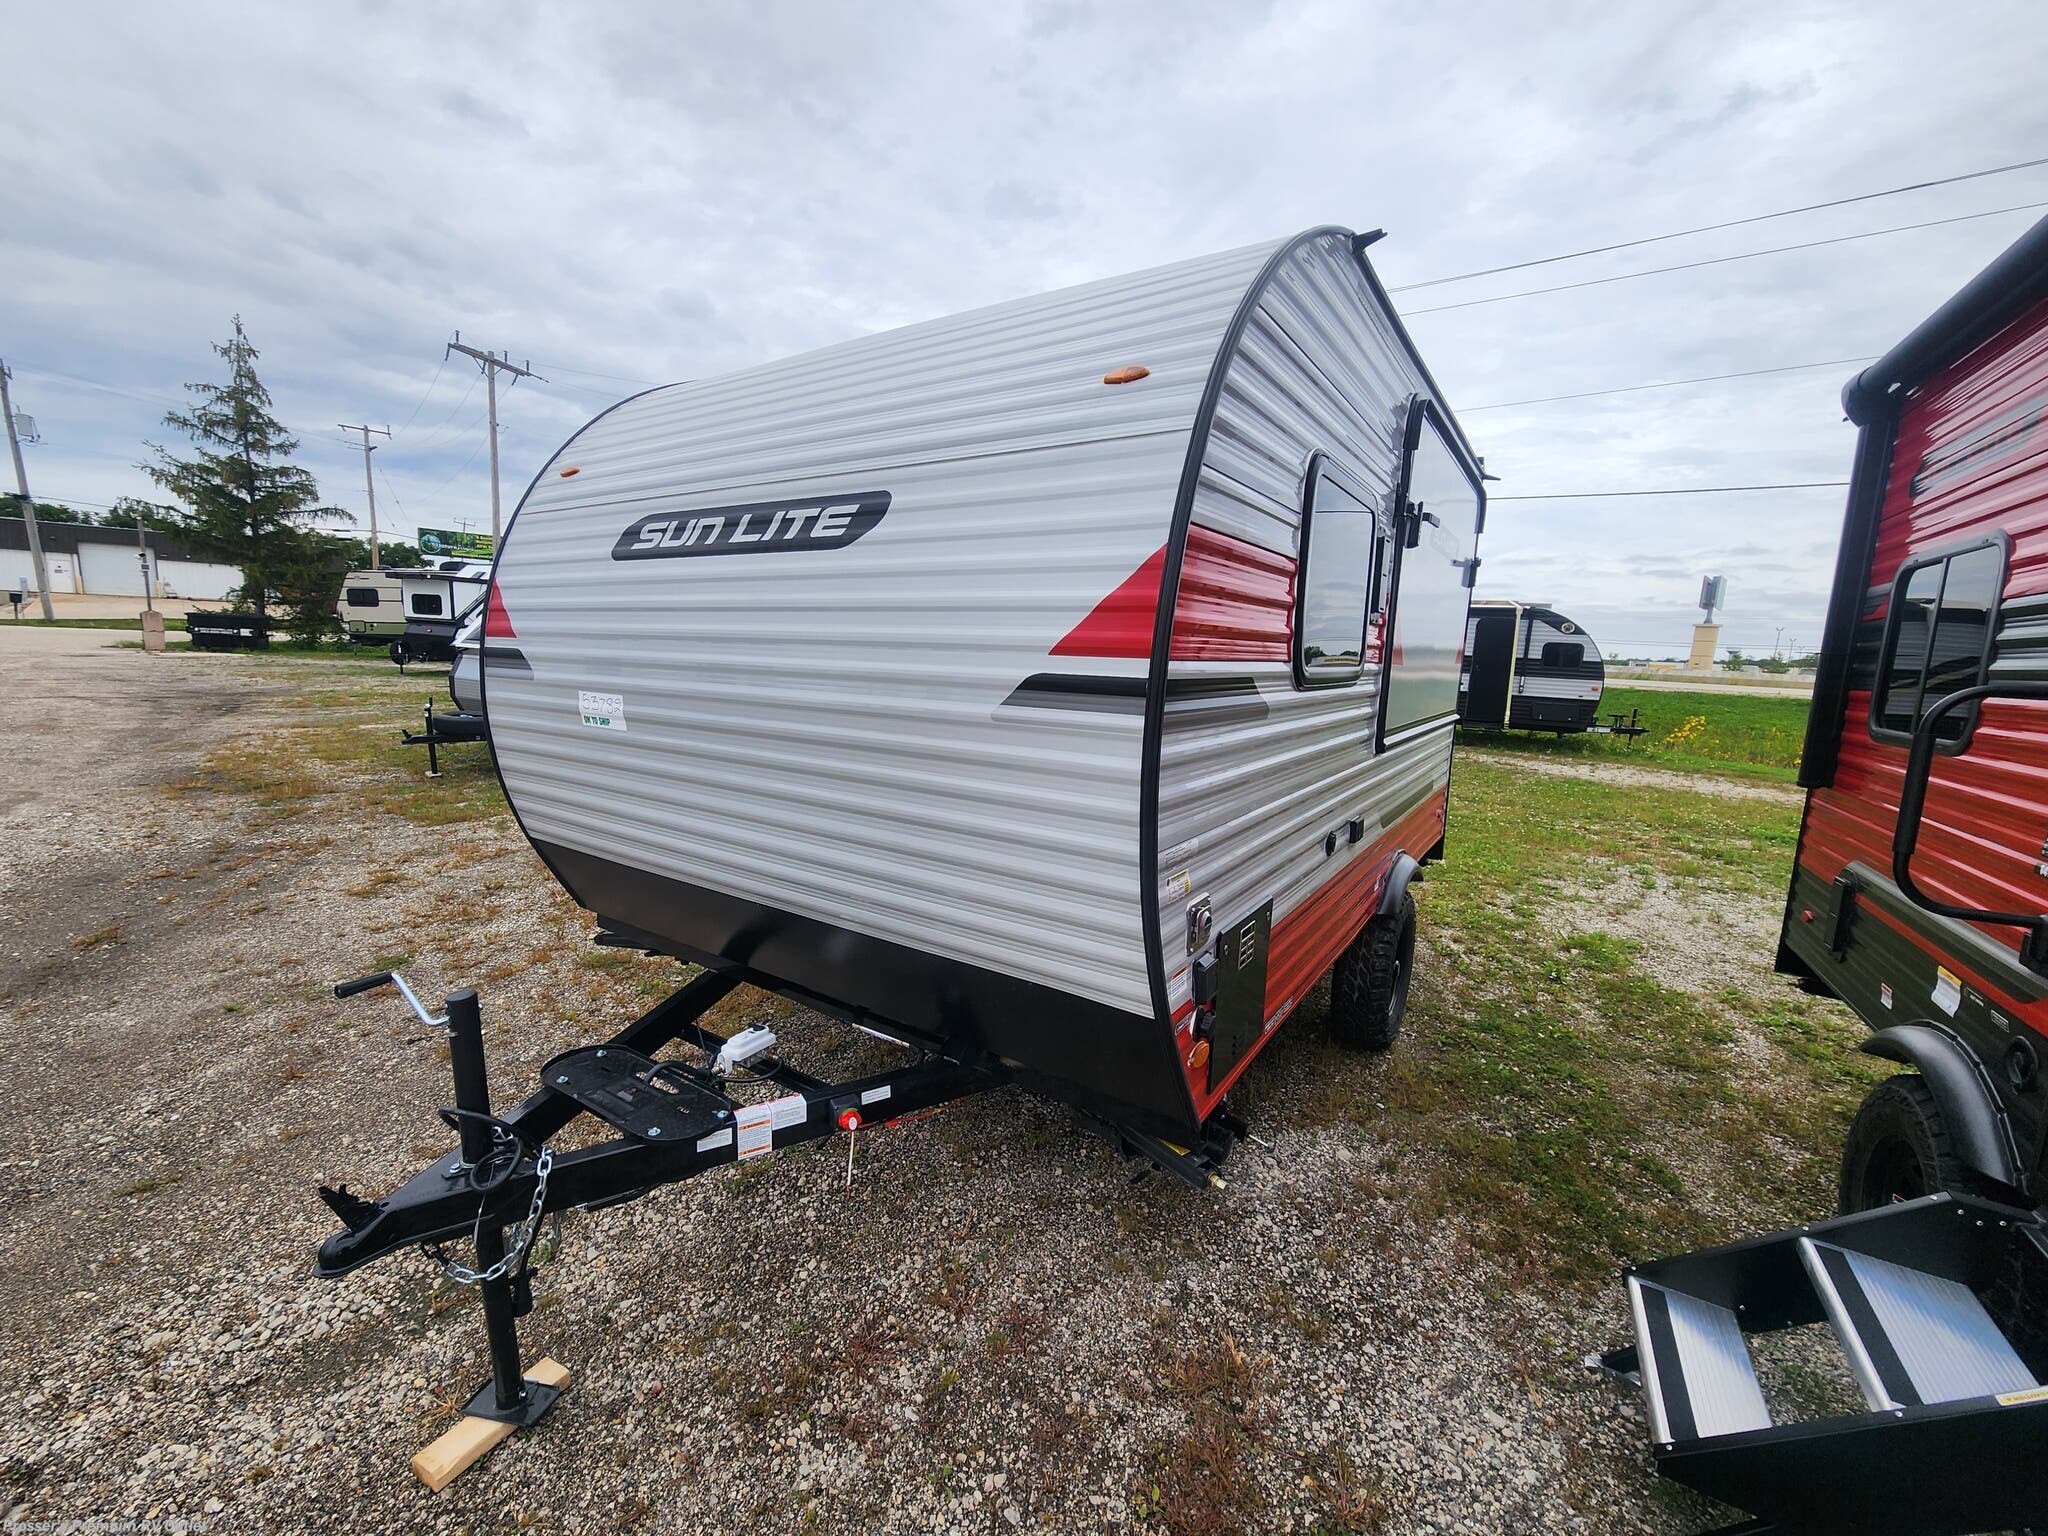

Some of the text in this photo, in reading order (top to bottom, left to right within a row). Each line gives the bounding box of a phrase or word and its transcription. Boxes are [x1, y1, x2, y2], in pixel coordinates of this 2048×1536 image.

[631, 504, 860, 549] SUN LITE
[584, 715, 610, 726] OK TO SHIP
